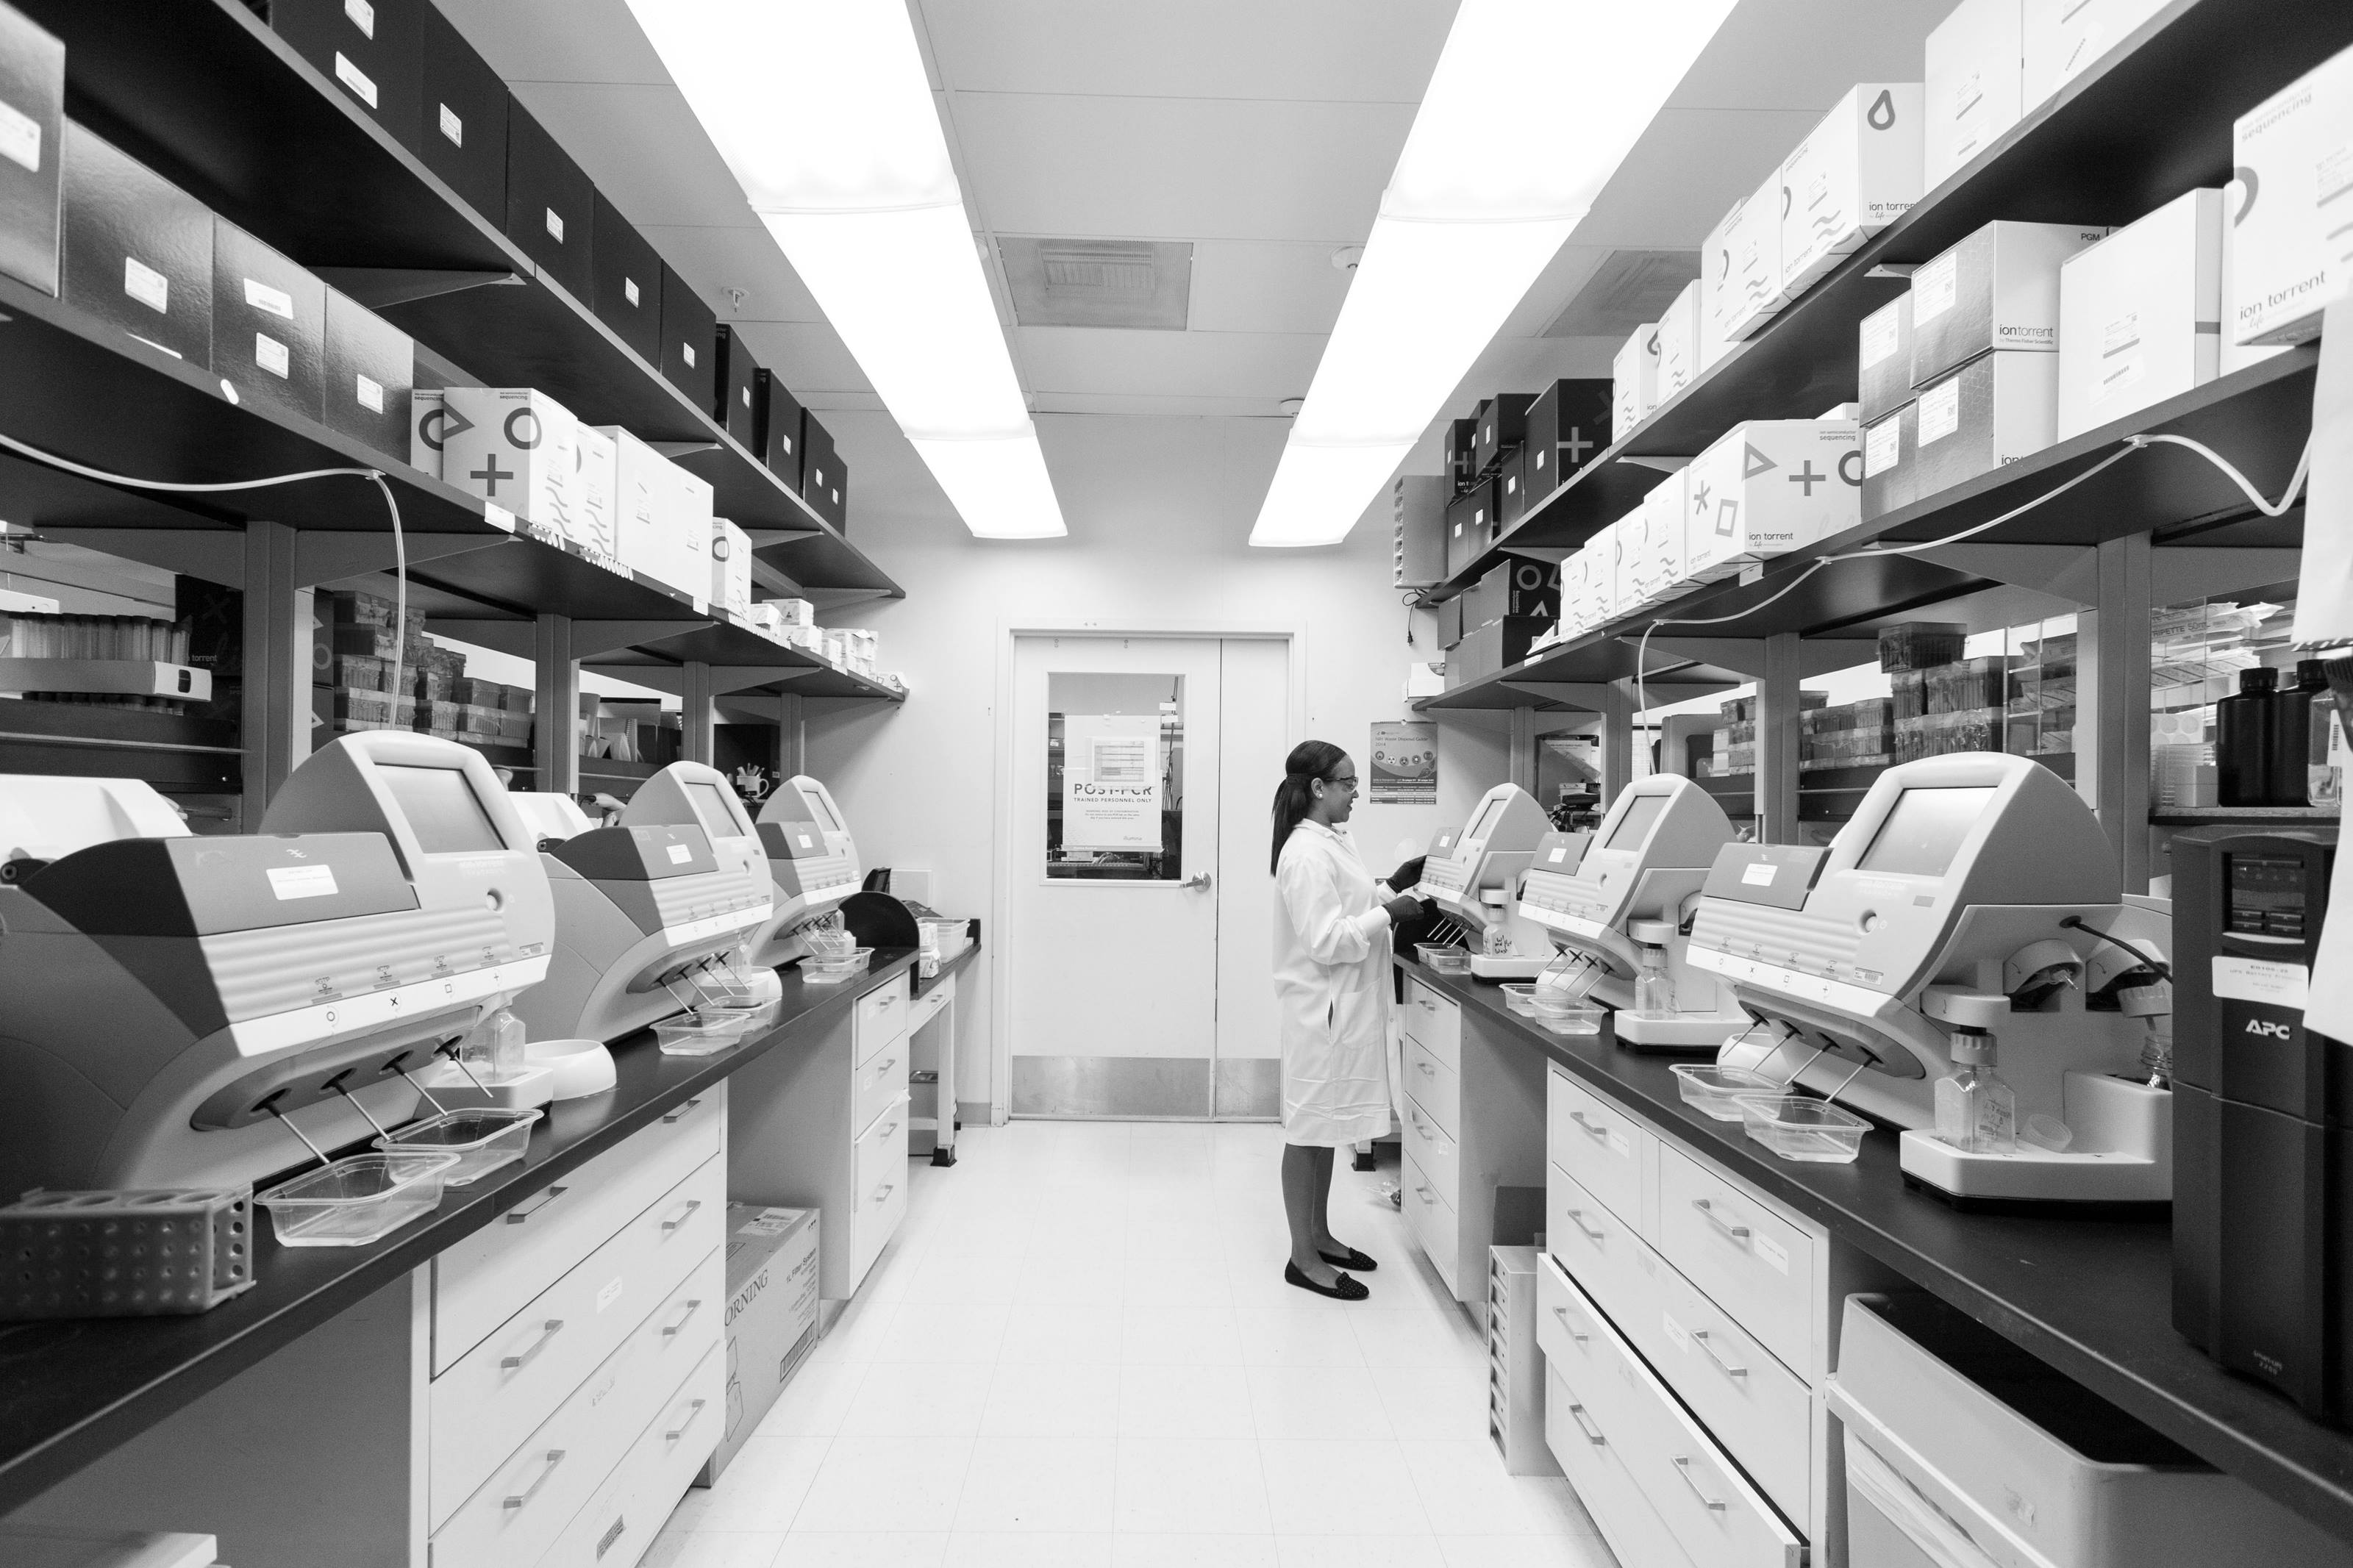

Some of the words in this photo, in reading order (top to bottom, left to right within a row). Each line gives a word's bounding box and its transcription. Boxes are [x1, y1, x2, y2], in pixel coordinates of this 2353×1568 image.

[2242, 93, 2312, 143] sequencing
[1868, 201, 1883, 211] ion
[1886, 201, 1918, 211] torren
[2081, 232, 2100, 241] PGM
[2240, 302, 2262, 321] ion
[2268, 270, 2326, 306] torrent
[1749, 532, 1761, 540] ion
[1764, 532, 1793, 540] torrent
[2246, 1019, 2290, 1040] APC
[724, 1269, 768, 1327] ORNING
